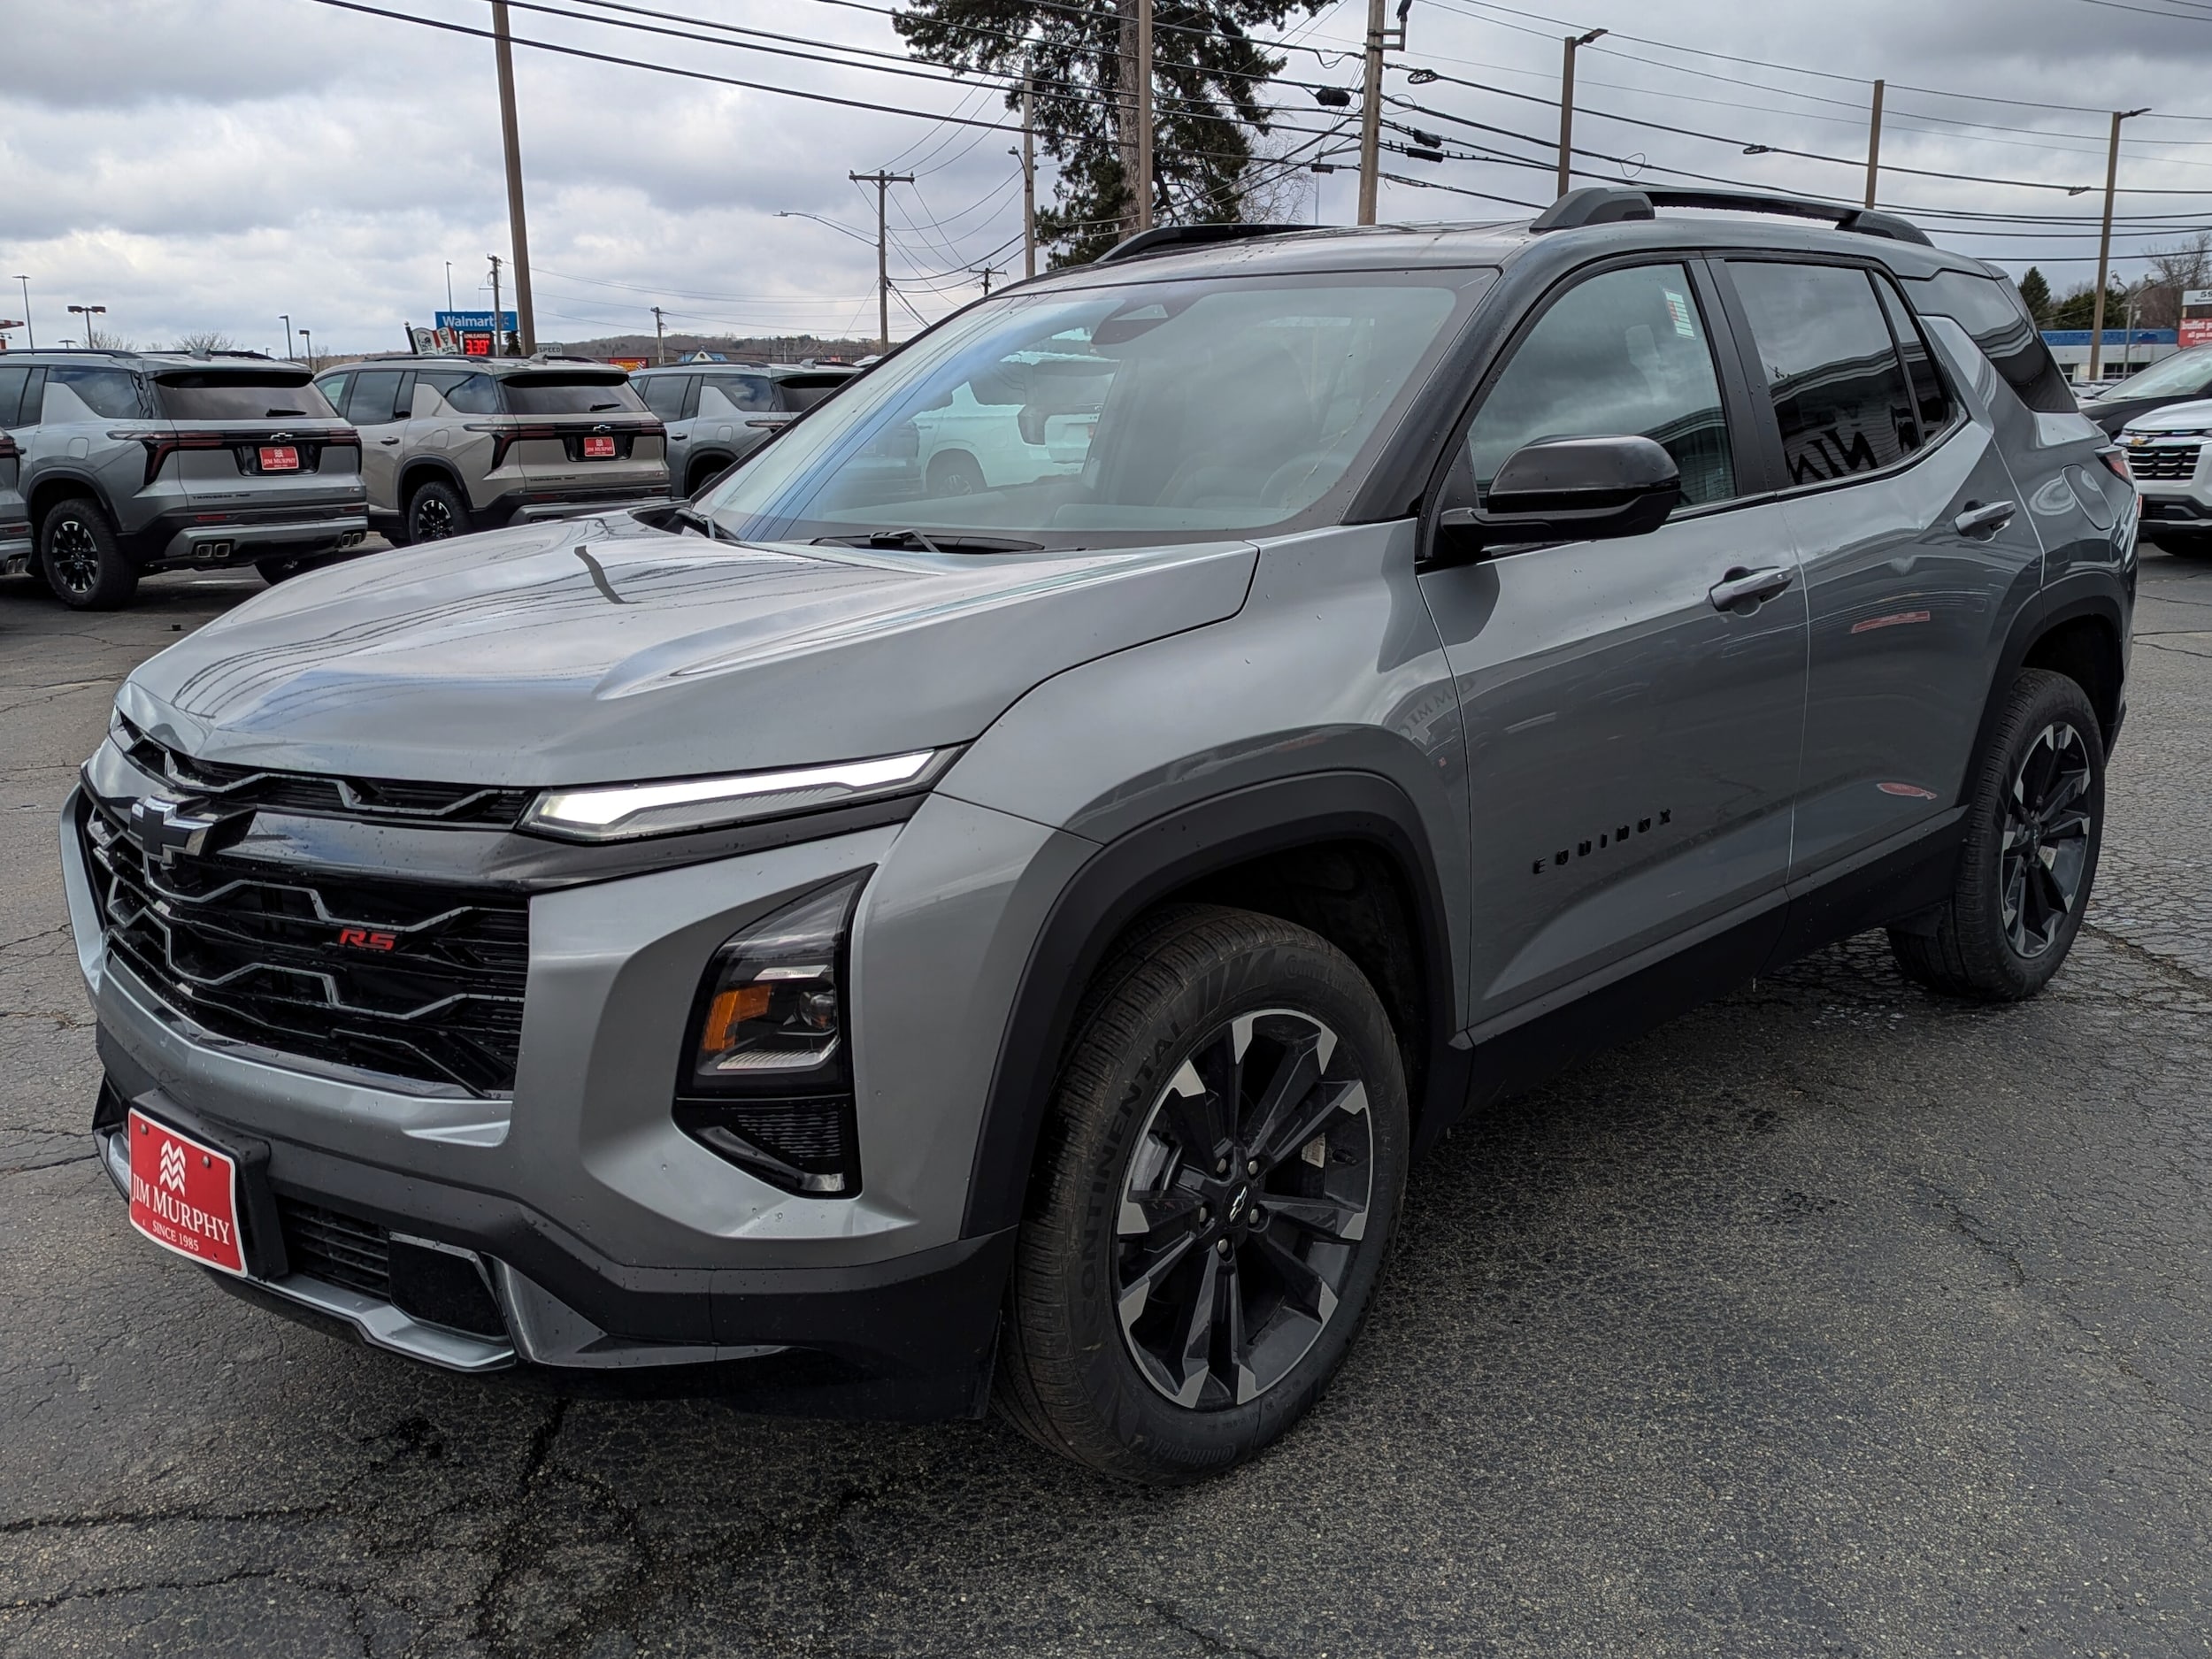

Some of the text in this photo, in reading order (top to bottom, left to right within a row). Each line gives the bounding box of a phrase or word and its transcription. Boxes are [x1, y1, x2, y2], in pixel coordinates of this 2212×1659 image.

[442, 316, 495, 327] Walmart
[1532, 808, 1671, 874] EQUINOX
[339, 928, 396, 951] RS
[1080, 1019, 1190, 1328] CONTINENTAL
[132, 1172, 230, 1246] JIM MURPHY
[152, 1221, 199, 1252] SINCE 1985
